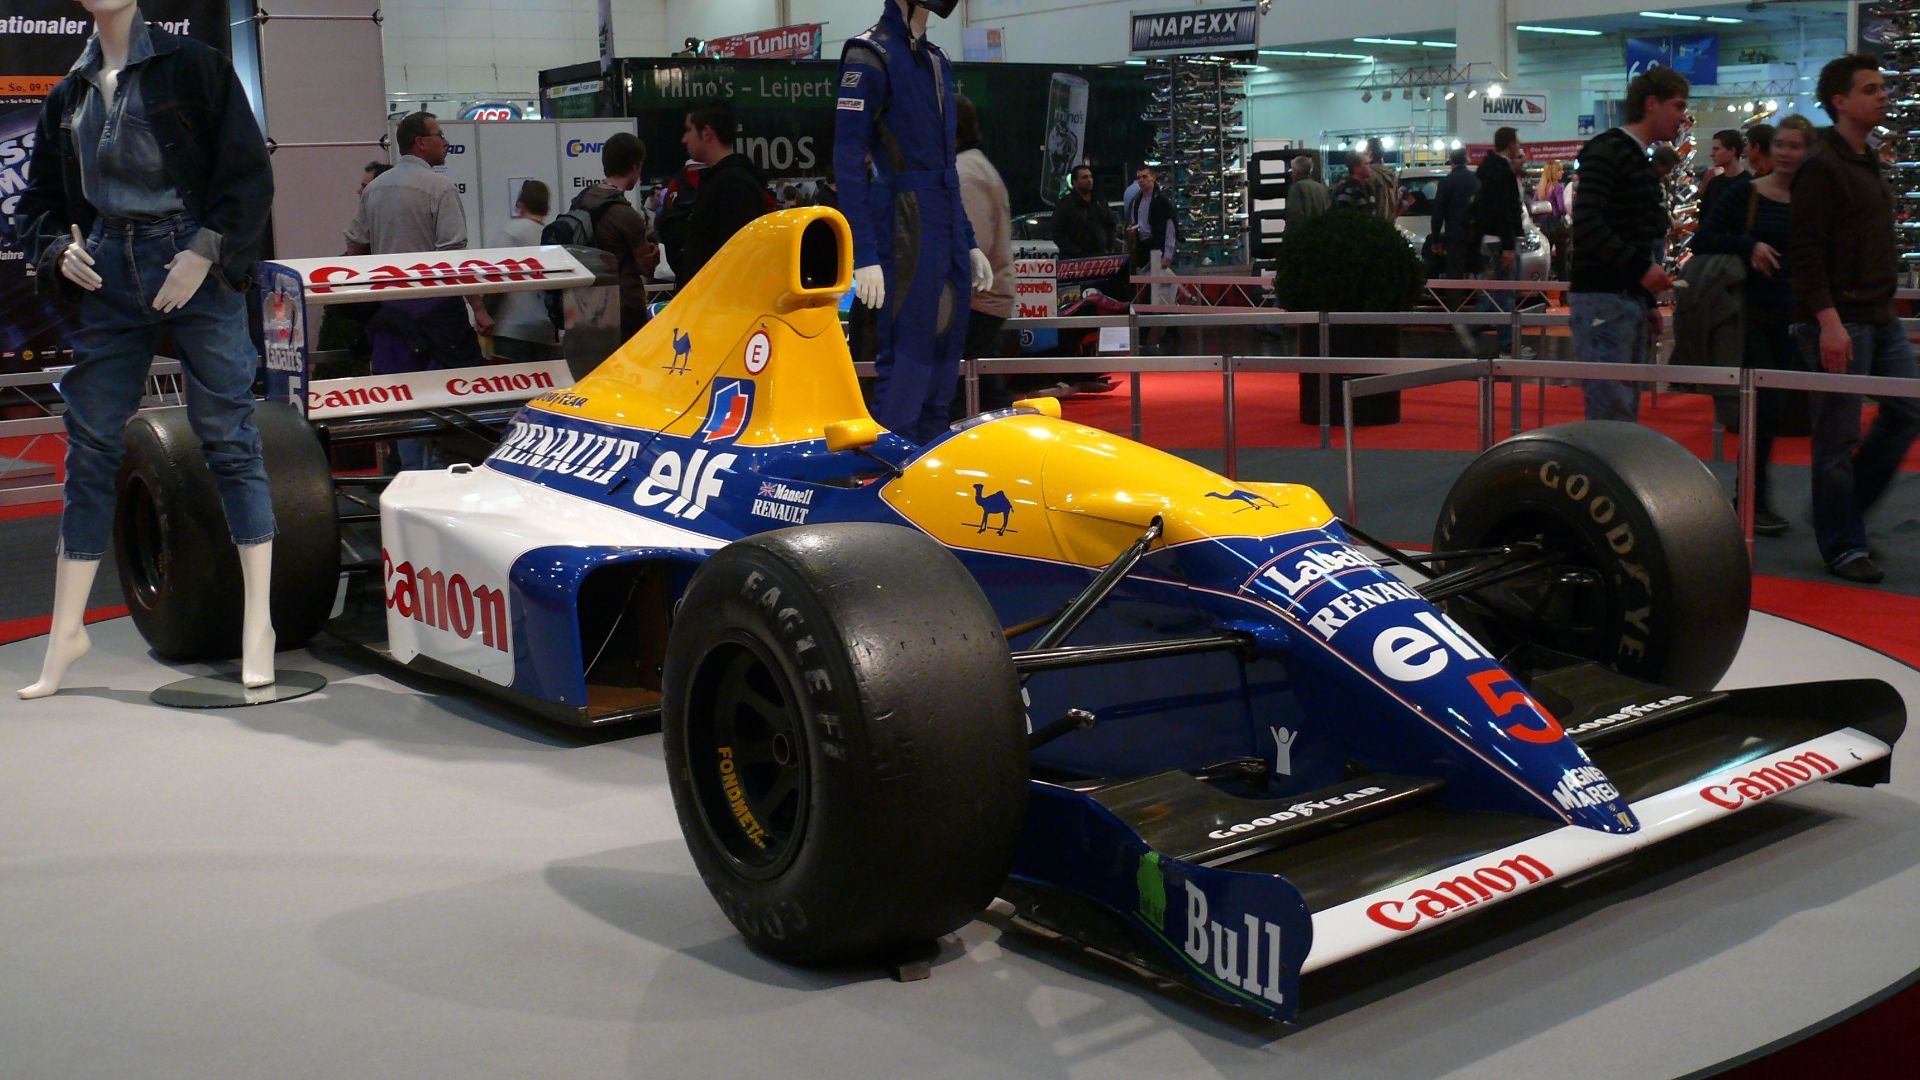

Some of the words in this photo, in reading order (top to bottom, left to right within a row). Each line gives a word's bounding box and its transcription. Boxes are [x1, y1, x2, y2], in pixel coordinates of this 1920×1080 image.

[1150, 12, 1238, 37] NAPEXX
[745, 31, 810, 56] Tuning
[760, 76, 832, 104] Leipert
[1482, 98, 1524, 114] HAWK
[309, 257, 550, 293] Canon
[752, 344, 762, 356] E
[307, 383, 414, 410] Canon
[446, 370, 555, 398] Canon
[489, 421, 641, 486] RENAULT
[633, 448, 738, 520] elf
[774, 482, 814, 506] Mansell
[751, 498, 810, 525] RENAULT
[382, 547, 509, 653] Canon
[1306, 581, 1428, 643] RENAU
[1465, 668, 1567, 744] 5
[1698, 750, 1840, 811] Canon
[1207, 785, 1387, 841] GOODYEAR
[1365, 853, 1555, 932] Canon
[1184, 878, 1284, 1005] Bull
